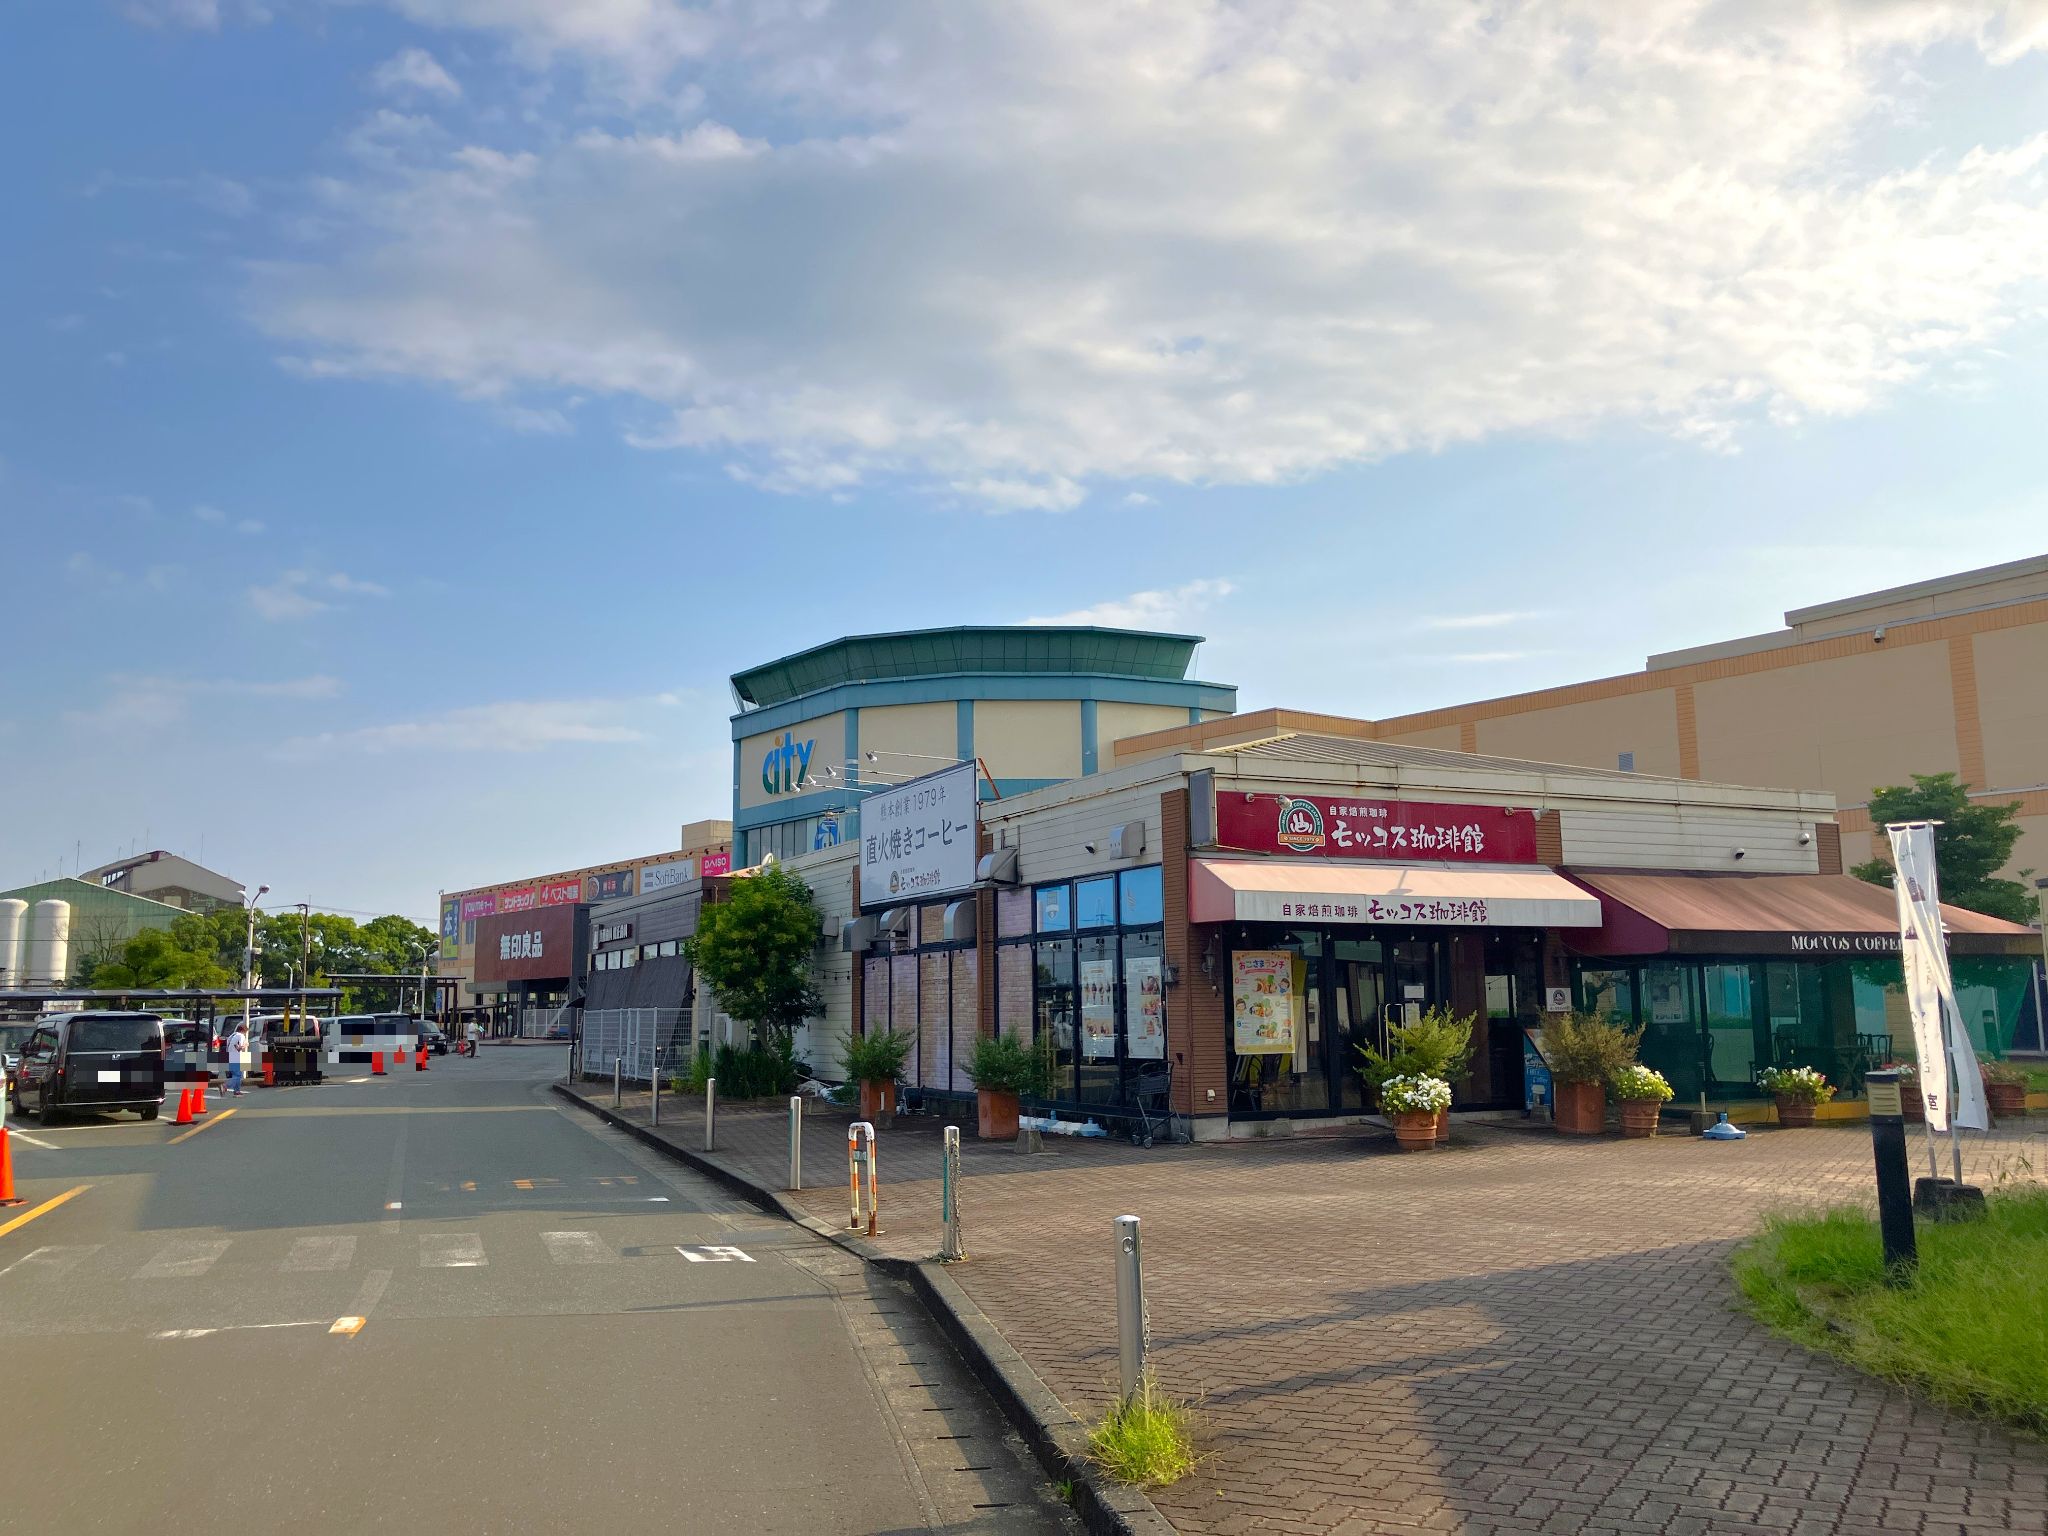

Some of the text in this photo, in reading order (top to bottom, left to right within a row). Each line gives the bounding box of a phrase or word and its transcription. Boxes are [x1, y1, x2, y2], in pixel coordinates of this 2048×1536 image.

[763, 732, 816, 795] city
[1329, 806, 1388, 818] 自家焙煎珈琲
[866, 819, 968, 866] 直火焼きコーヒー
[1331, 819, 1484, 854] モッコス珈琲館
[704, 857, 727, 869] DAISO
[655, 867, 689, 887] SoftBank
[1282, 899, 1488, 923] 自家焙煎珈琲 モッコス珈琲館
[500, 930, 543, 960] 無印良品
[1791, 935, 1850, 951] MOCCOS
[1239, 960, 1285, 970] おこさまランチ
